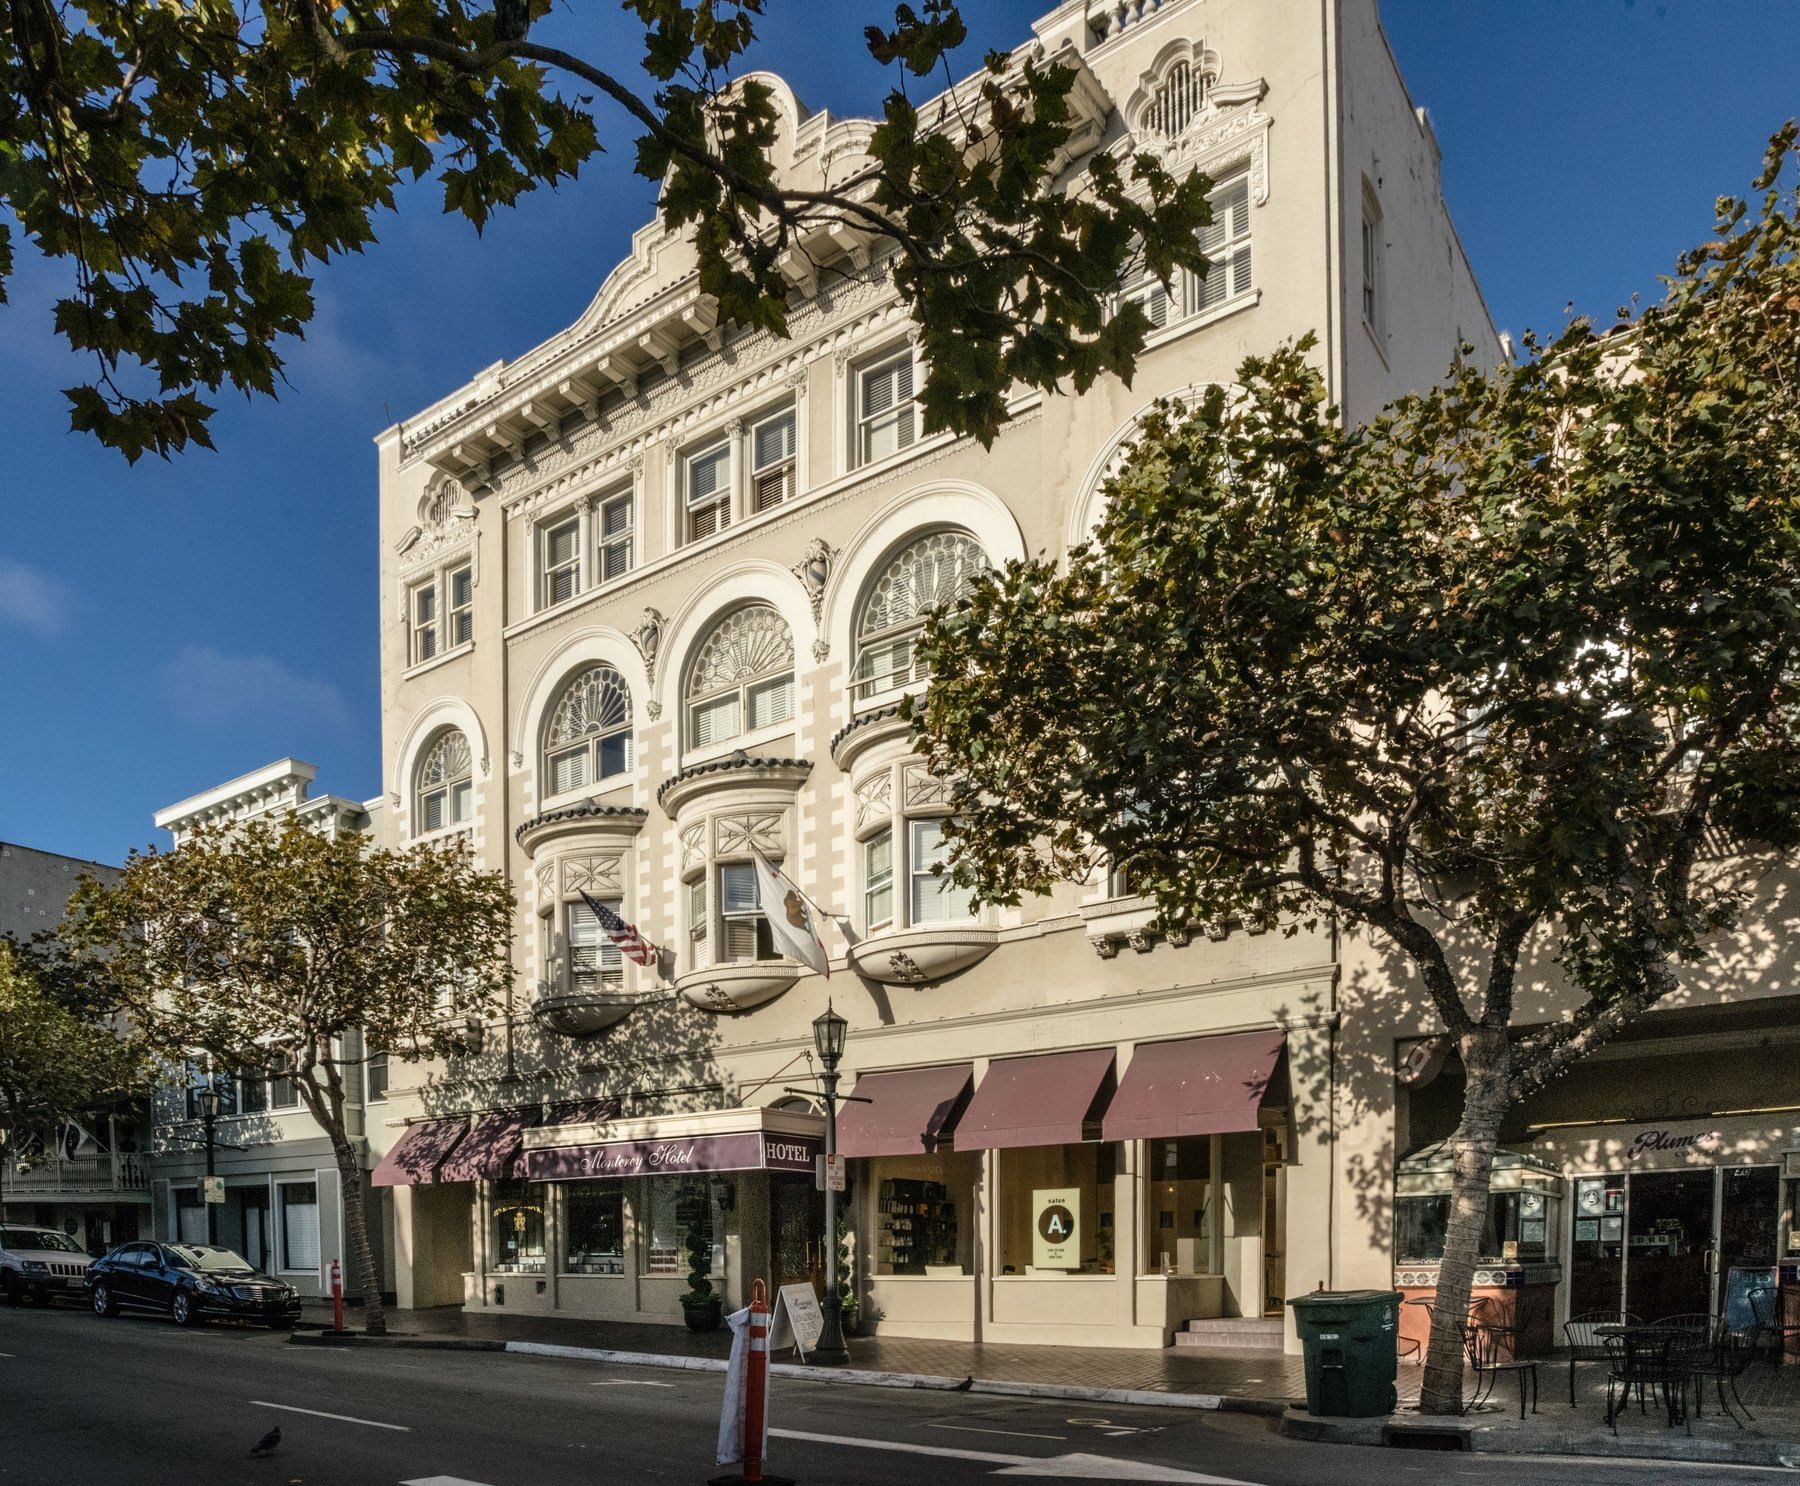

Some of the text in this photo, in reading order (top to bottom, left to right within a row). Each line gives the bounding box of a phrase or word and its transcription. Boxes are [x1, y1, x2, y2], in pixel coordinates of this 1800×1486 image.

[580, 1143, 695, 1174] Monterey Hotel
[765, 1142, 810, 1162] HOTEL
[792, 1312, 820, 1323] LOADING
[800, 1321, 817, 1330] ZONE
